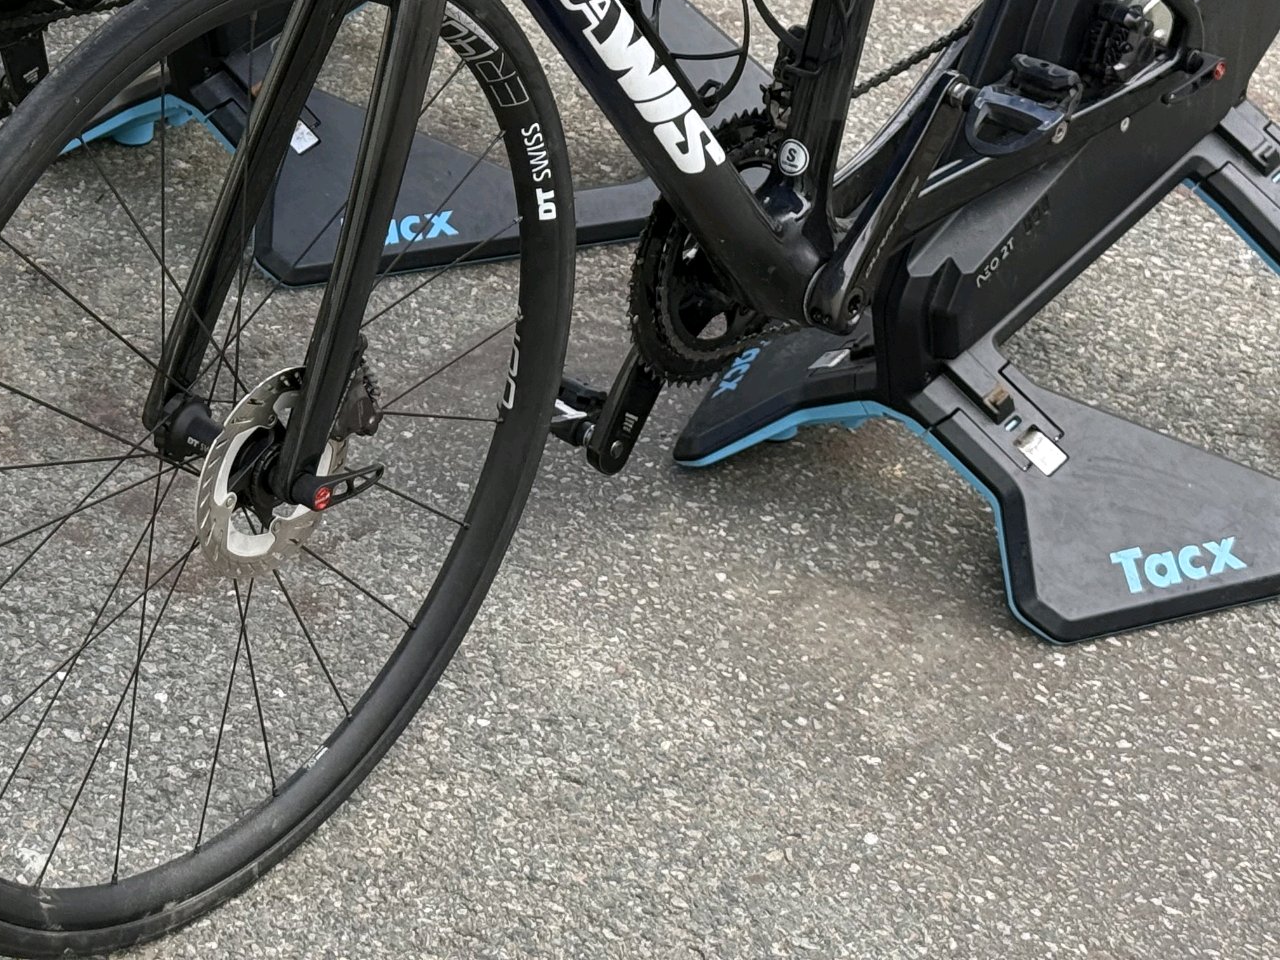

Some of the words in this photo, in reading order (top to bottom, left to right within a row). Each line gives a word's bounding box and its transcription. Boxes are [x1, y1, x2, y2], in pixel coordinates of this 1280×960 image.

[521, 122, 552, 182] SWISS
[535, 188, 557, 221] DT
[1109, 536, 1248, 594] Tacx
